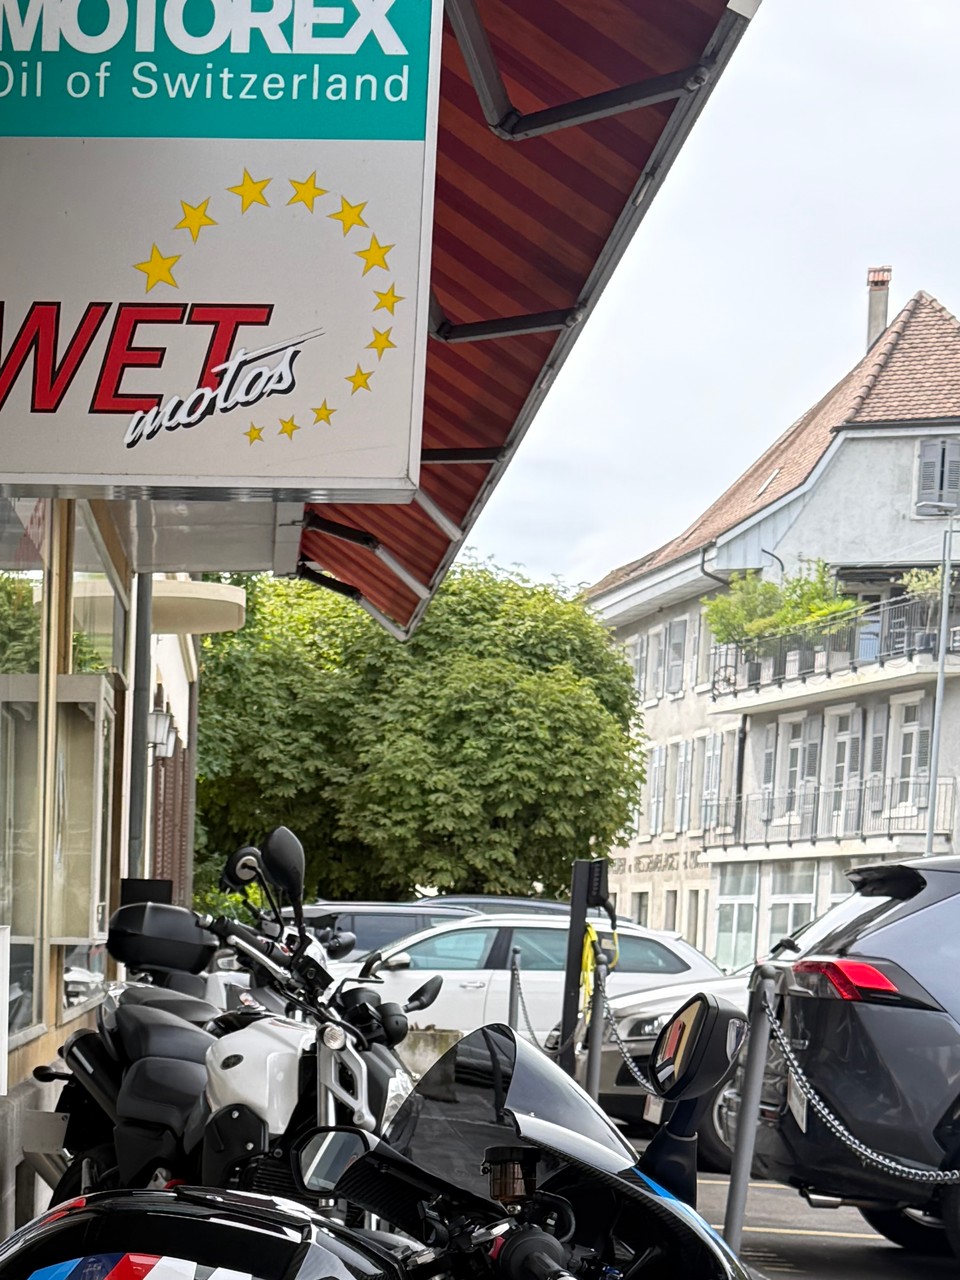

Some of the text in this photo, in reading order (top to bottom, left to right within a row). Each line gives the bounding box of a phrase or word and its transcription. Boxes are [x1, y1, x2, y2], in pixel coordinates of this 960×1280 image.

[66, 61, 111, 98] of
[131, 61, 409, 102] Switzerland
[124, 327, 326, 449] motos
